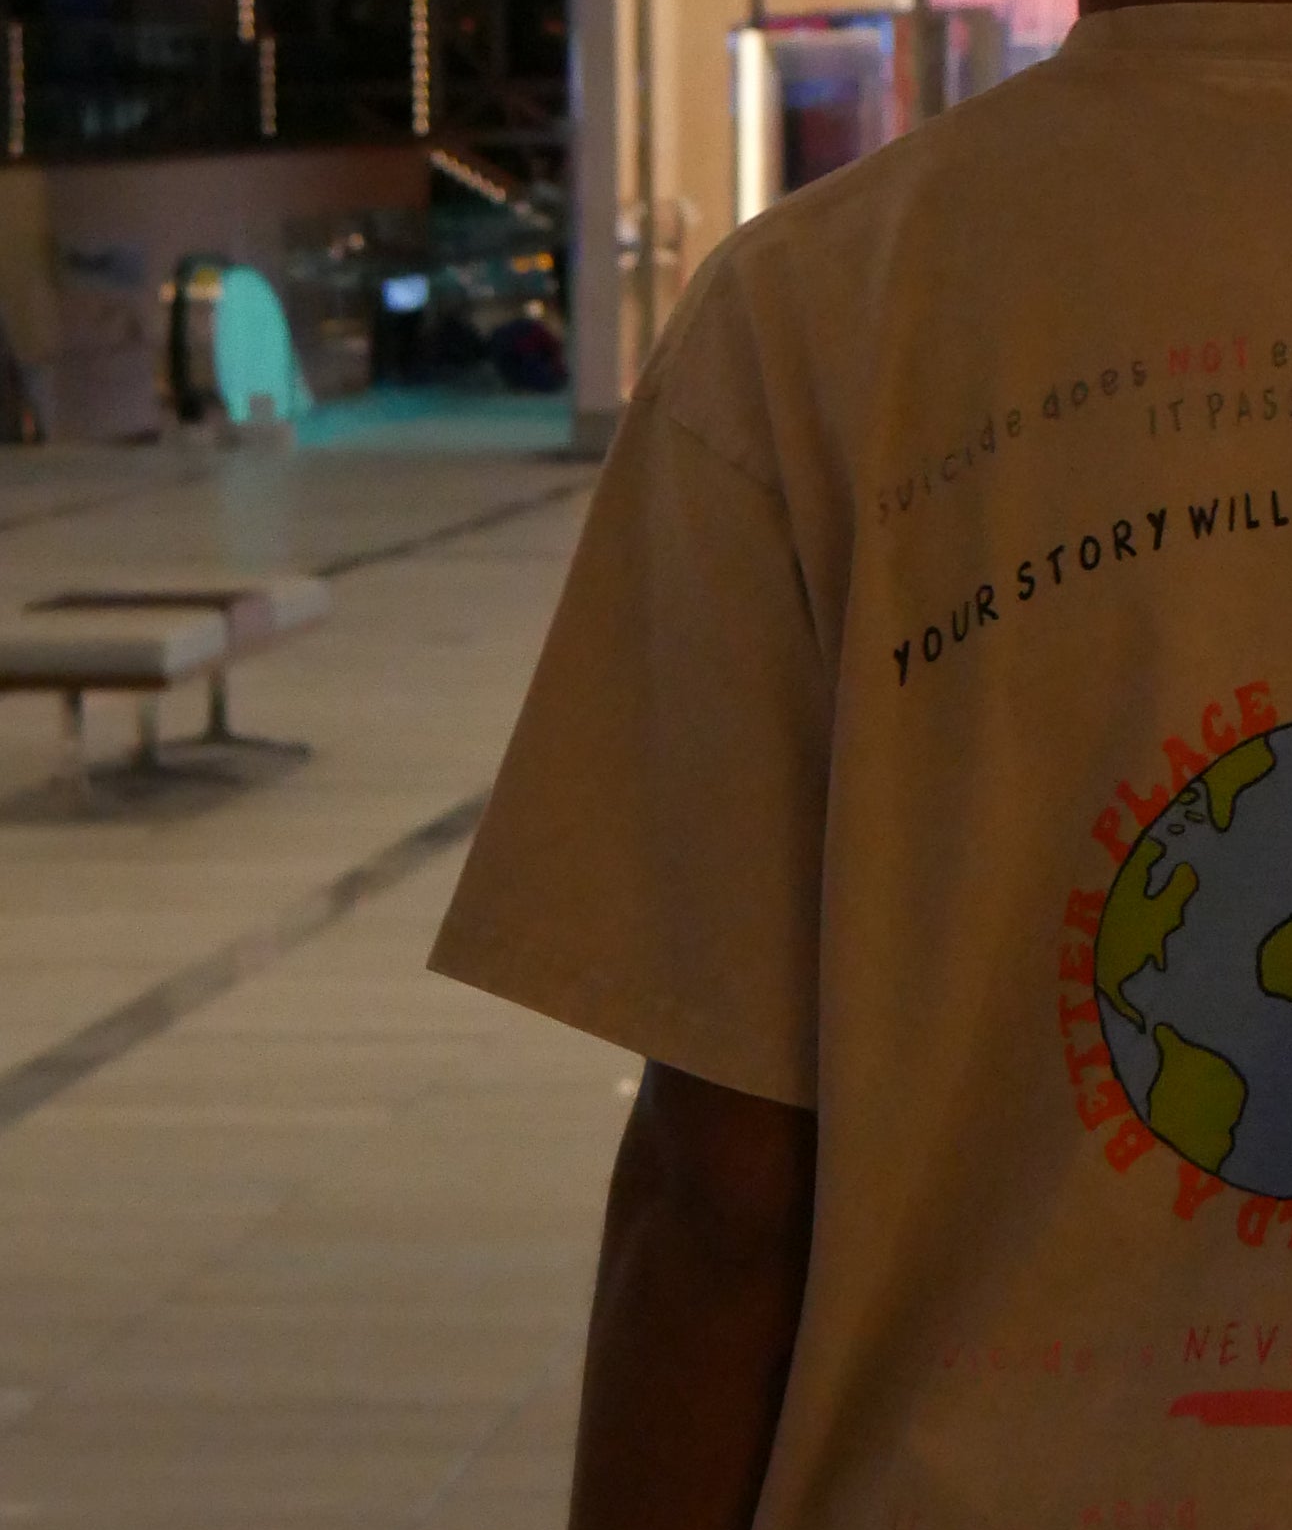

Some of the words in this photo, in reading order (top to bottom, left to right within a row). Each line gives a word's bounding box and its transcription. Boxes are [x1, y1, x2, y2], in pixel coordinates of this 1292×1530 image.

[1042, 359, 1148, 421] does
[1166, 336, 1248, 375] NOT
[1147, 397, 1185, 437] IT
[892, 584, 1000, 688] YOUR
[1015, 506, 1168, 601] STORY
[1187, 489, 1290, 540] WILL
[1090, 680, 1279, 865] PLACE
[1057, 888, 1158, 1175] BETTER
[1171, 1163, 1228, 1222] A
